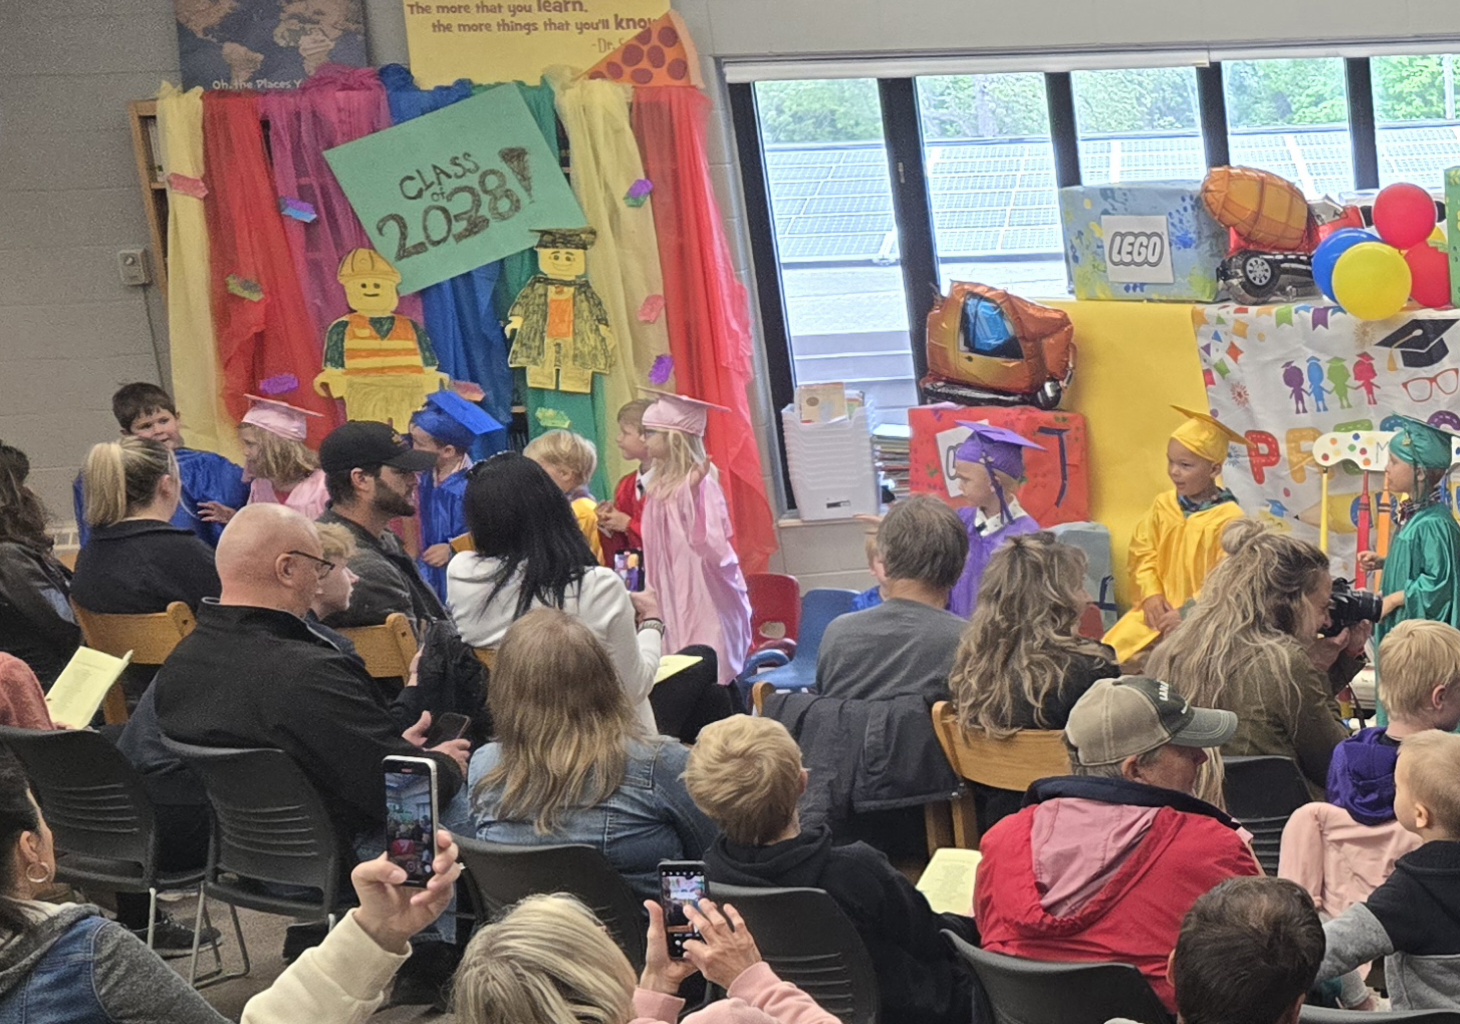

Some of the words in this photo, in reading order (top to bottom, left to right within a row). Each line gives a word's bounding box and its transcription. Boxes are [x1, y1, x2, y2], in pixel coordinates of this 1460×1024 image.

[407, 3, 432, 15] The
[436, 4, 471, 14] more
[475, 2, 502, 14] that
[507, 3, 532, 17] you
[432, 21, 453, 33] the
[458, 22, 492, 32] more
[497, 20, 538, 35] things
[543, 18, 571, 32] that
[575, 18, 610, 35] you'll
[255, 78, 291, 90] Places
[399, 152, 480, 200] CLASS
[1109, 231, 1164, 267] LEGO
